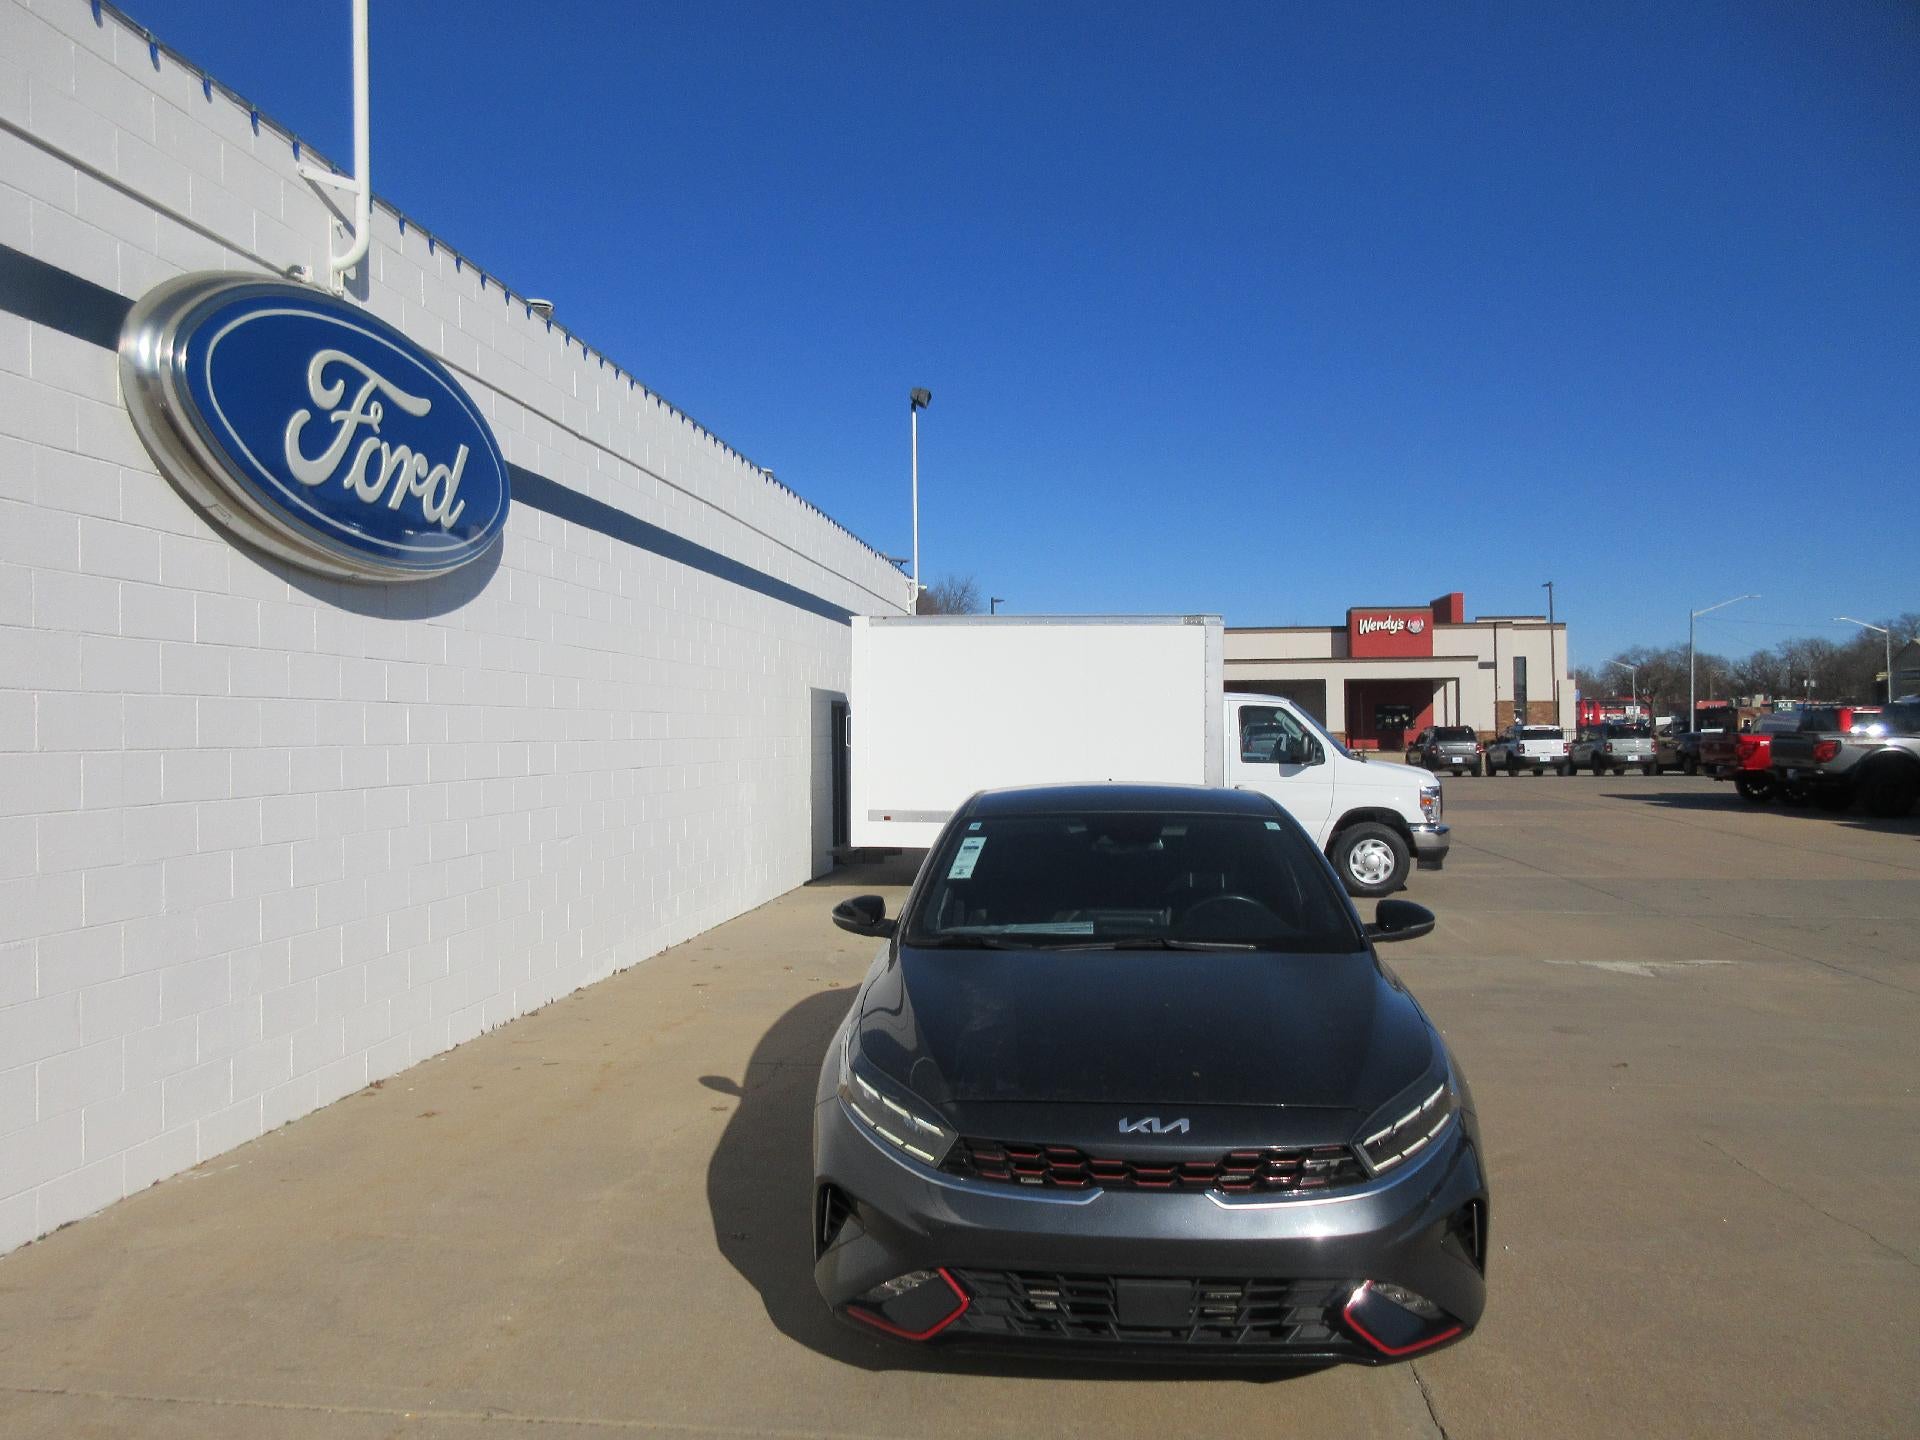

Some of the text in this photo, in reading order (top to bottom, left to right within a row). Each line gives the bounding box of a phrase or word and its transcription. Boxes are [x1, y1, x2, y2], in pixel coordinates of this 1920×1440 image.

[285, 349, 469, 528] Ford
[1359, 615, 1404, 634] Wendy's
[1119, 1117, 1190, 1134] KIA
